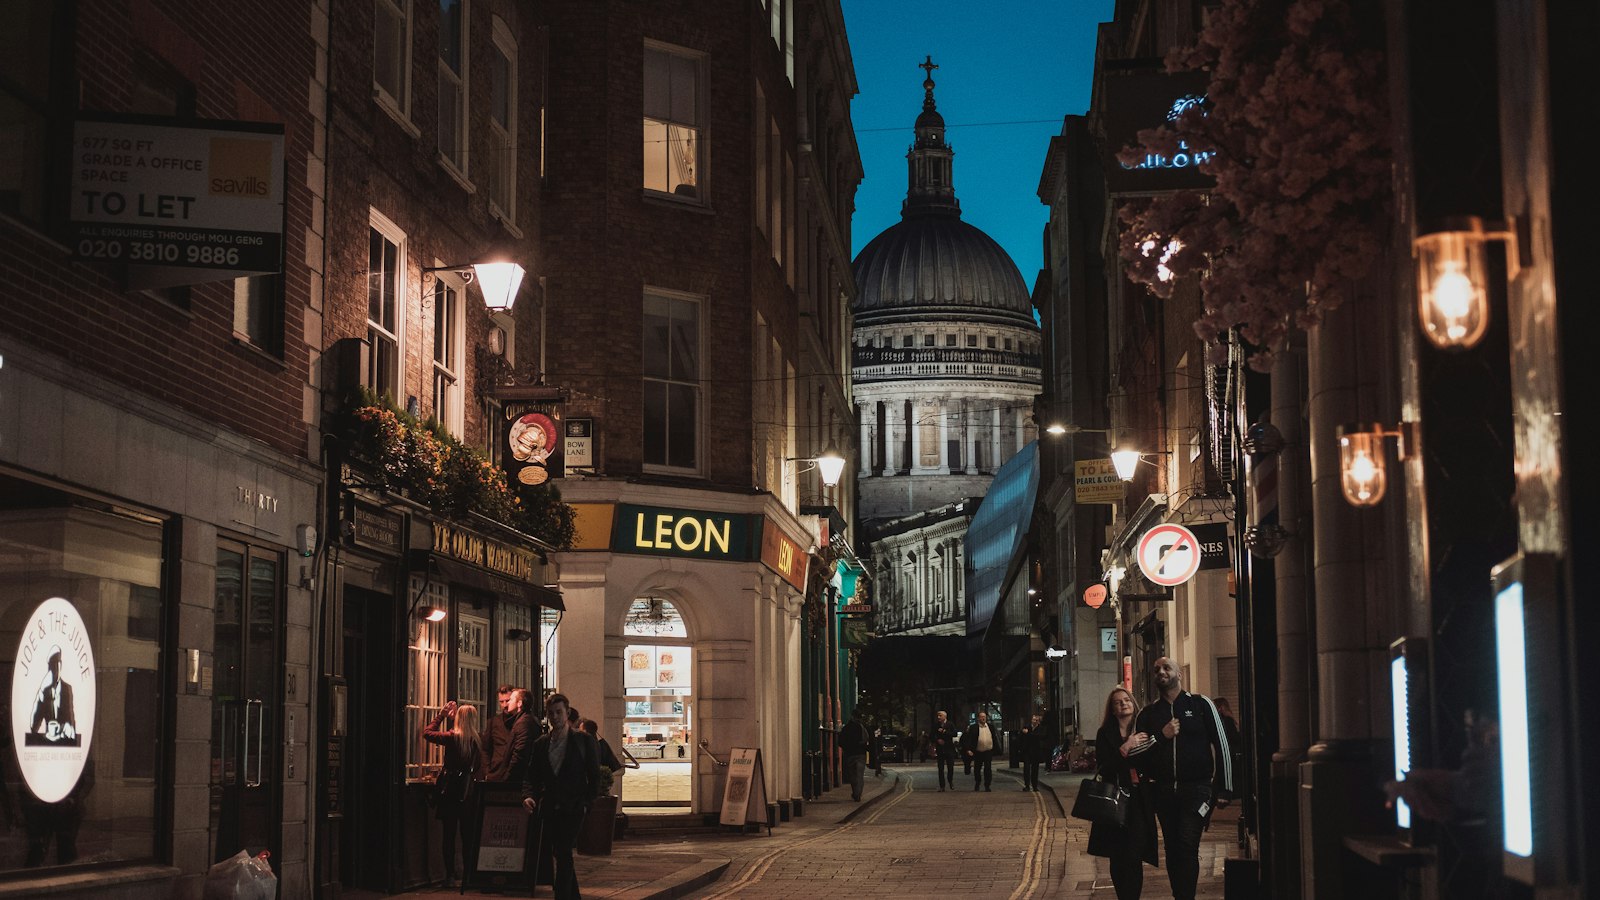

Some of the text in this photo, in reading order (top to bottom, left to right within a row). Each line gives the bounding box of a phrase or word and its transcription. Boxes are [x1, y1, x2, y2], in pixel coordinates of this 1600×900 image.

[82, 137, 153, 151] 677 SQ FT
[82, 153, 203, 172] GRADE A OFFICE
[81, 169, 128, 182] SPACE
[211, 176, 267, 196] savills
[82, 191, 196, 219] TO LET
[79, 227, 263, 246] ALL ENQUIRIES THROUGH MOLI GENG
[78, 239, 239, 265] 020 3810 9886
[1076, 476, 1096, 485] PEARL
[1103, 475, 1120, 483] COU
[1080, 465, 1115, 476] TO LE
[236, 486, 278, 513] THIRTY
[635, 512, 731, 554] LEON
[432, 521, 532, 582] YE OLDE WATLING
[778, 538, 793, 576] LEON
[1199, 541, 1223, 553] NES
[20, 611, 91, 681] JOE & THE JUICE
[287, 673, 296, 695] 30
